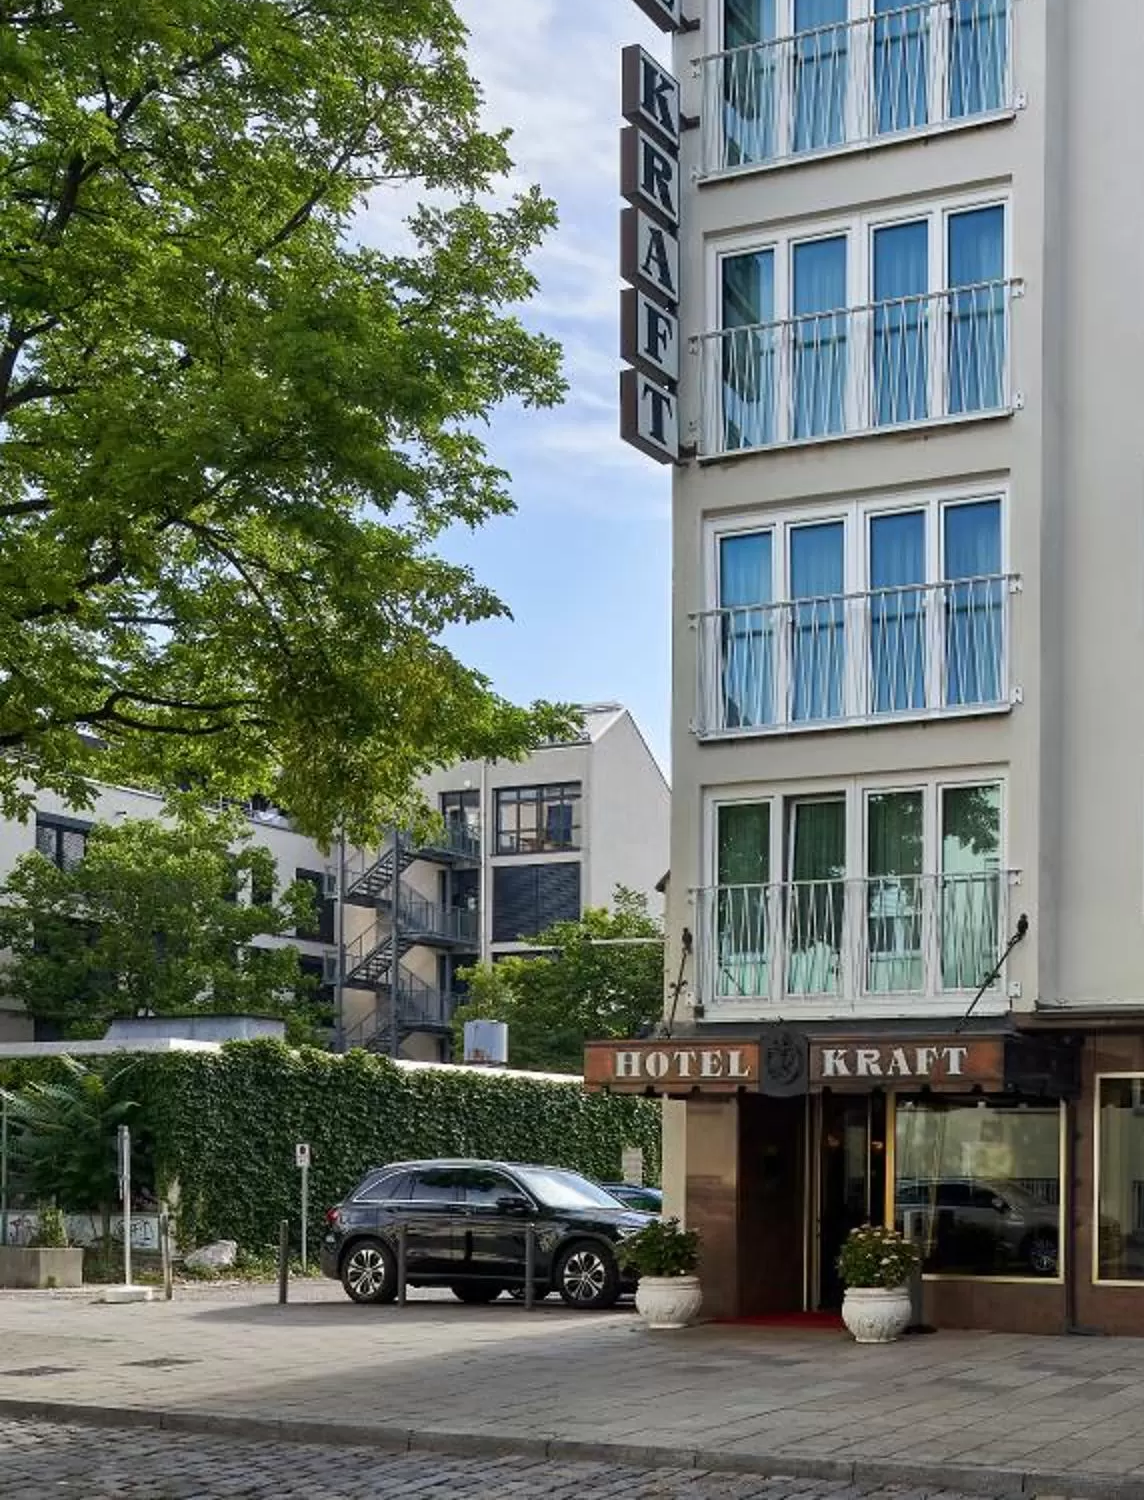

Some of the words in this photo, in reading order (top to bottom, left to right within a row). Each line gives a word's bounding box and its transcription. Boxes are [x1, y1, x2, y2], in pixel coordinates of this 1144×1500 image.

[641, 57, 677, 446] KRAFT
[614, 1051, 751, 1077] HOTEL
[821, 1047, 968, 1076] KRAFT
